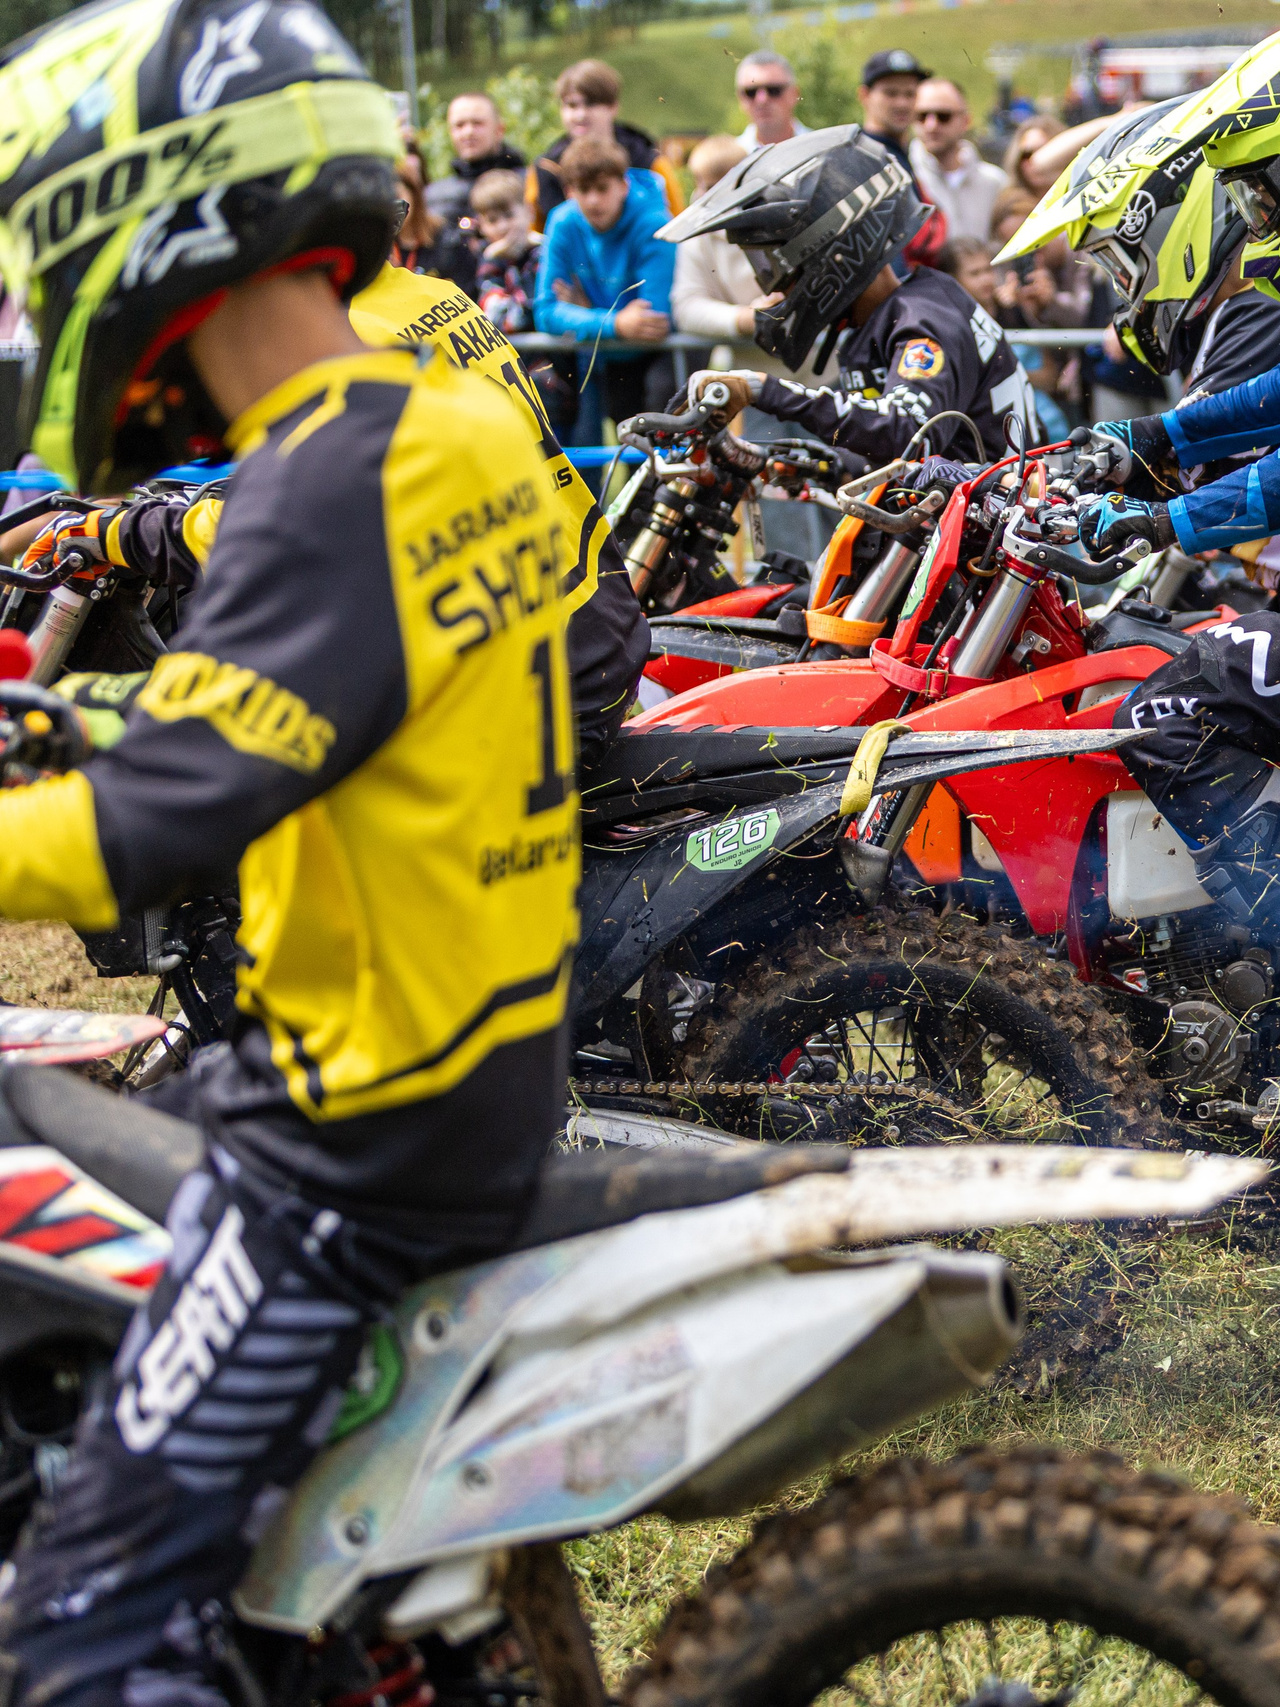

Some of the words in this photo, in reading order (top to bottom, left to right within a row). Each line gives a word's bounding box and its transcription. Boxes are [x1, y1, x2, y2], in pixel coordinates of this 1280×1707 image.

[1131, 697, 1199, 730] FOX
[696, 814, 770, 863] 126
[710, 853, 737, 867] ENDURO
[738, 844, 762, 857] JUNIOR
[733, 859, 742, 867] J2
[114, 1203, 264, 1454] LEATT
